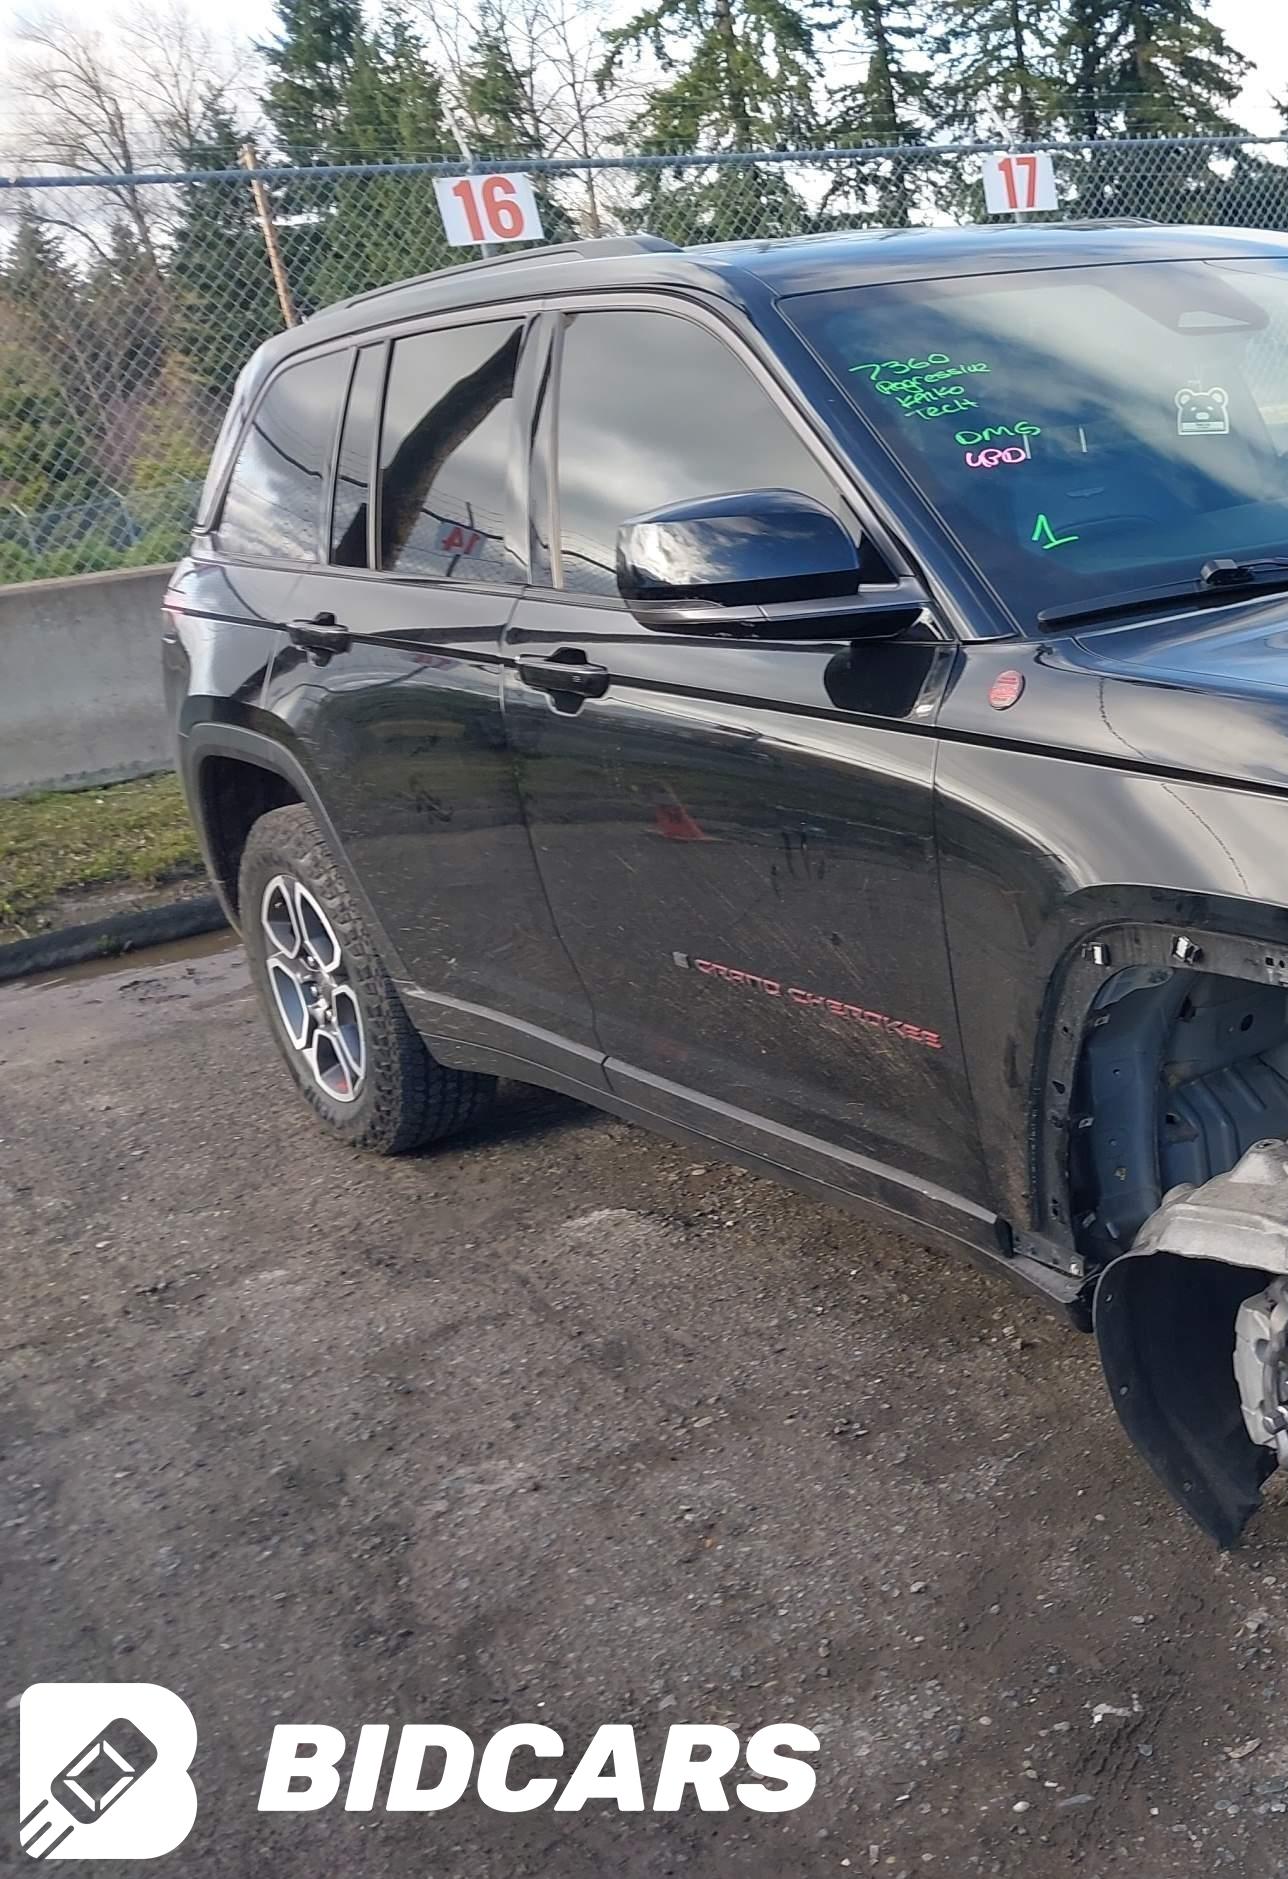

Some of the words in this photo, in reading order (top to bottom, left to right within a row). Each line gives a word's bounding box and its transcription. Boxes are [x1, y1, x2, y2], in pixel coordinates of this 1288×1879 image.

[453, 176, 525, 240] 16
[998, 156, 1038, 208] 17
[848, 353, 950, 380] 7360
[1031, 514, 1079, 549] 1
[695, 959, 781, 996] GRAND
[788, 987, 944, 1049] CHEROKEE
